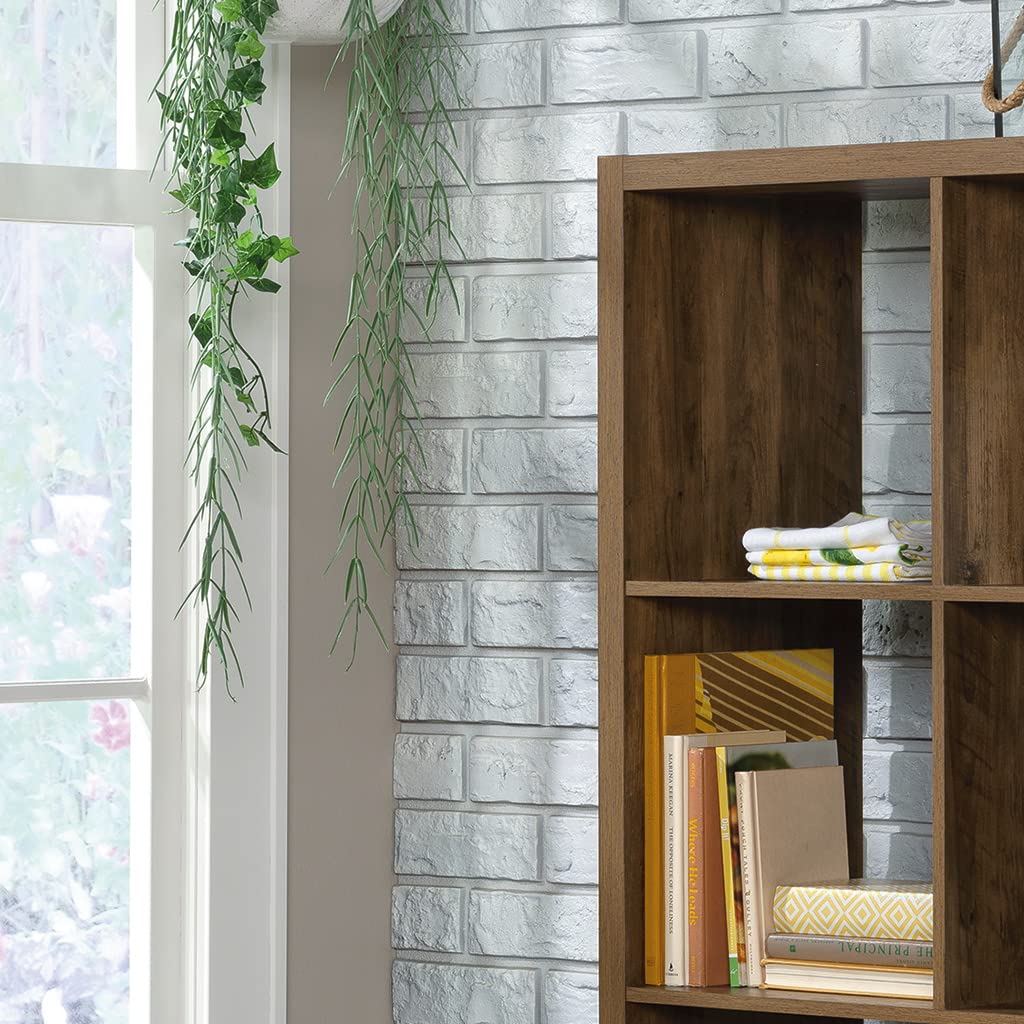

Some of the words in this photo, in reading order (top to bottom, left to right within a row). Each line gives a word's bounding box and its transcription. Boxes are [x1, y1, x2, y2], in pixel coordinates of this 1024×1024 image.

[688, 818, 698, 864] Where
[669, 879, 674, 890] OF
[688, 867, 698, 887] He
[688, 889, 698, 926] Leads
[838, 941, 910, 957] PRINCIPAL
[917, 946, 933, 958] HE
